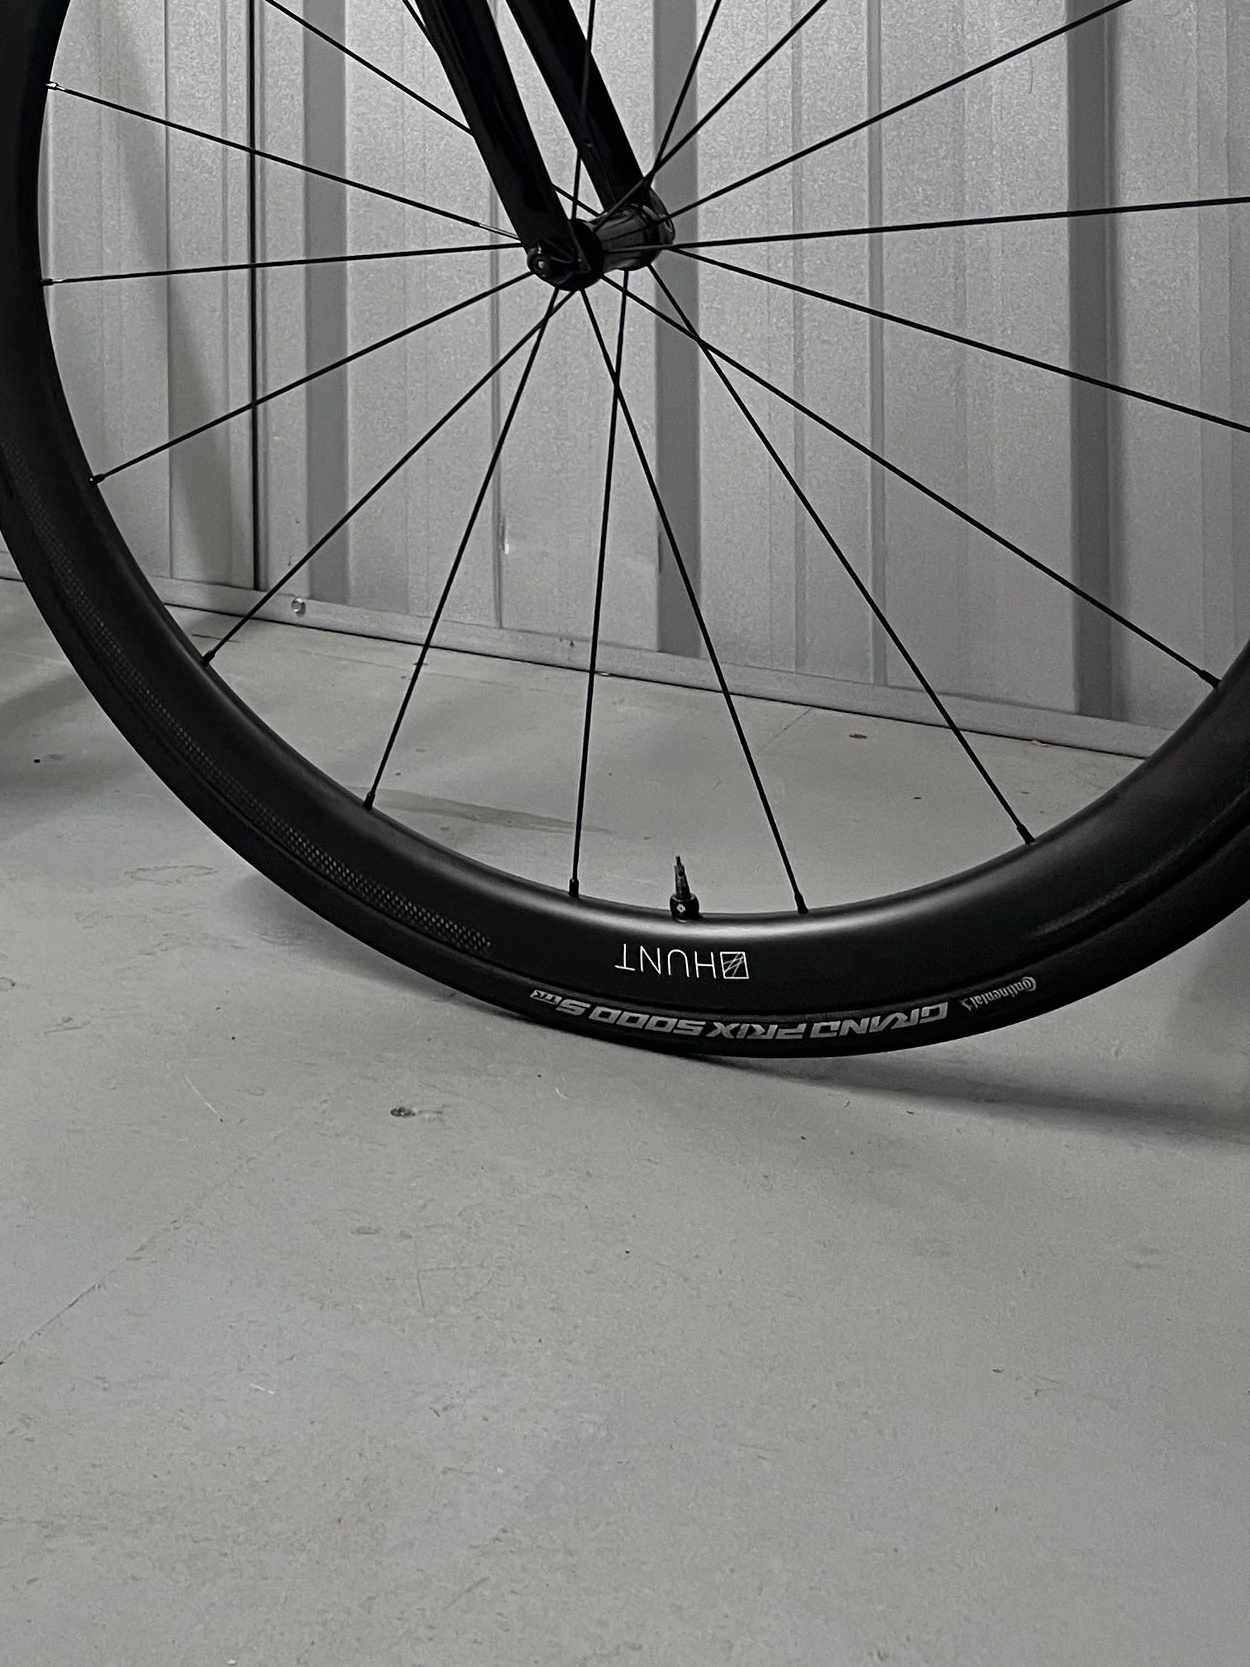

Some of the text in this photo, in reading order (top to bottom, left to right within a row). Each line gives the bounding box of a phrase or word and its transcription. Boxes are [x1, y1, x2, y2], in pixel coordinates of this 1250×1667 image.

[614, 943, 717, 979] HUNT
[588, 1007, 706, 1035] 5000
[705, 1021, 807, 1039] PRIX
[809, 1002, 949, 1039] GRAND
